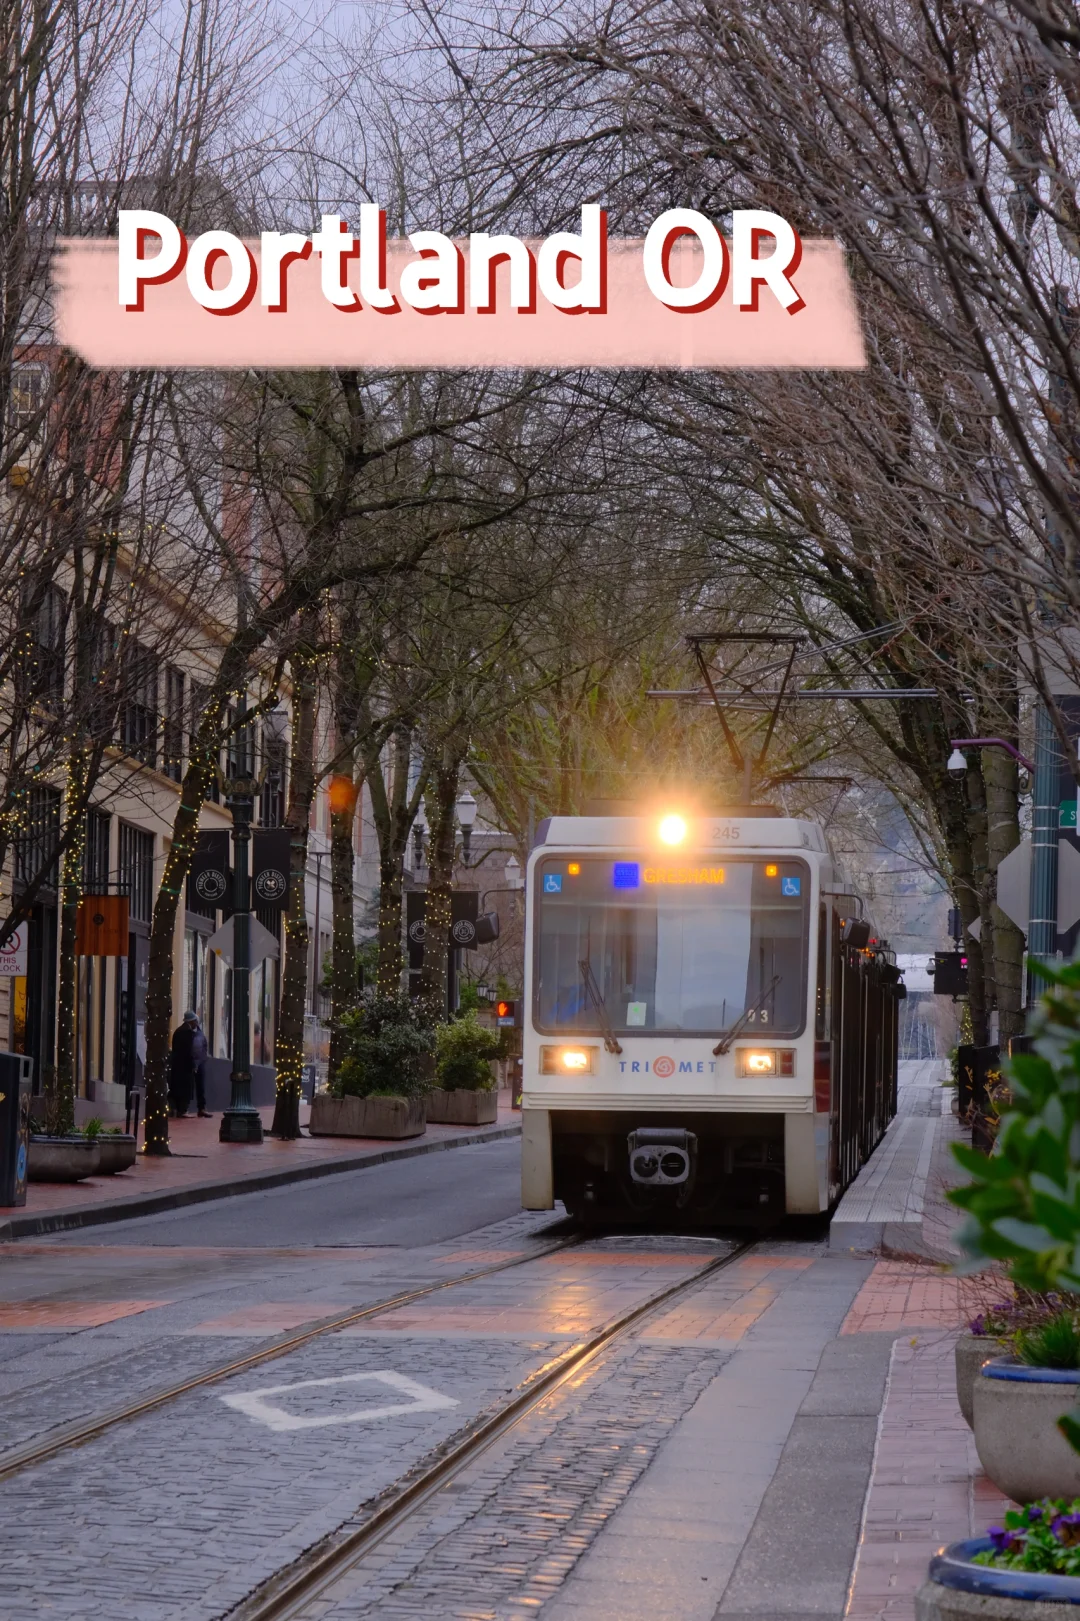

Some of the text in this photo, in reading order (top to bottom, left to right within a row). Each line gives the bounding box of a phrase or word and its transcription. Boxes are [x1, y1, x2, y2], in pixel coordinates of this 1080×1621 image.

[712, 826, 740, 840] 245
[643, 867, 725, 884] GRESHAM
[0, 964, 21, 972] OCK
[618, 1061, 717, 1073] TRI MET
